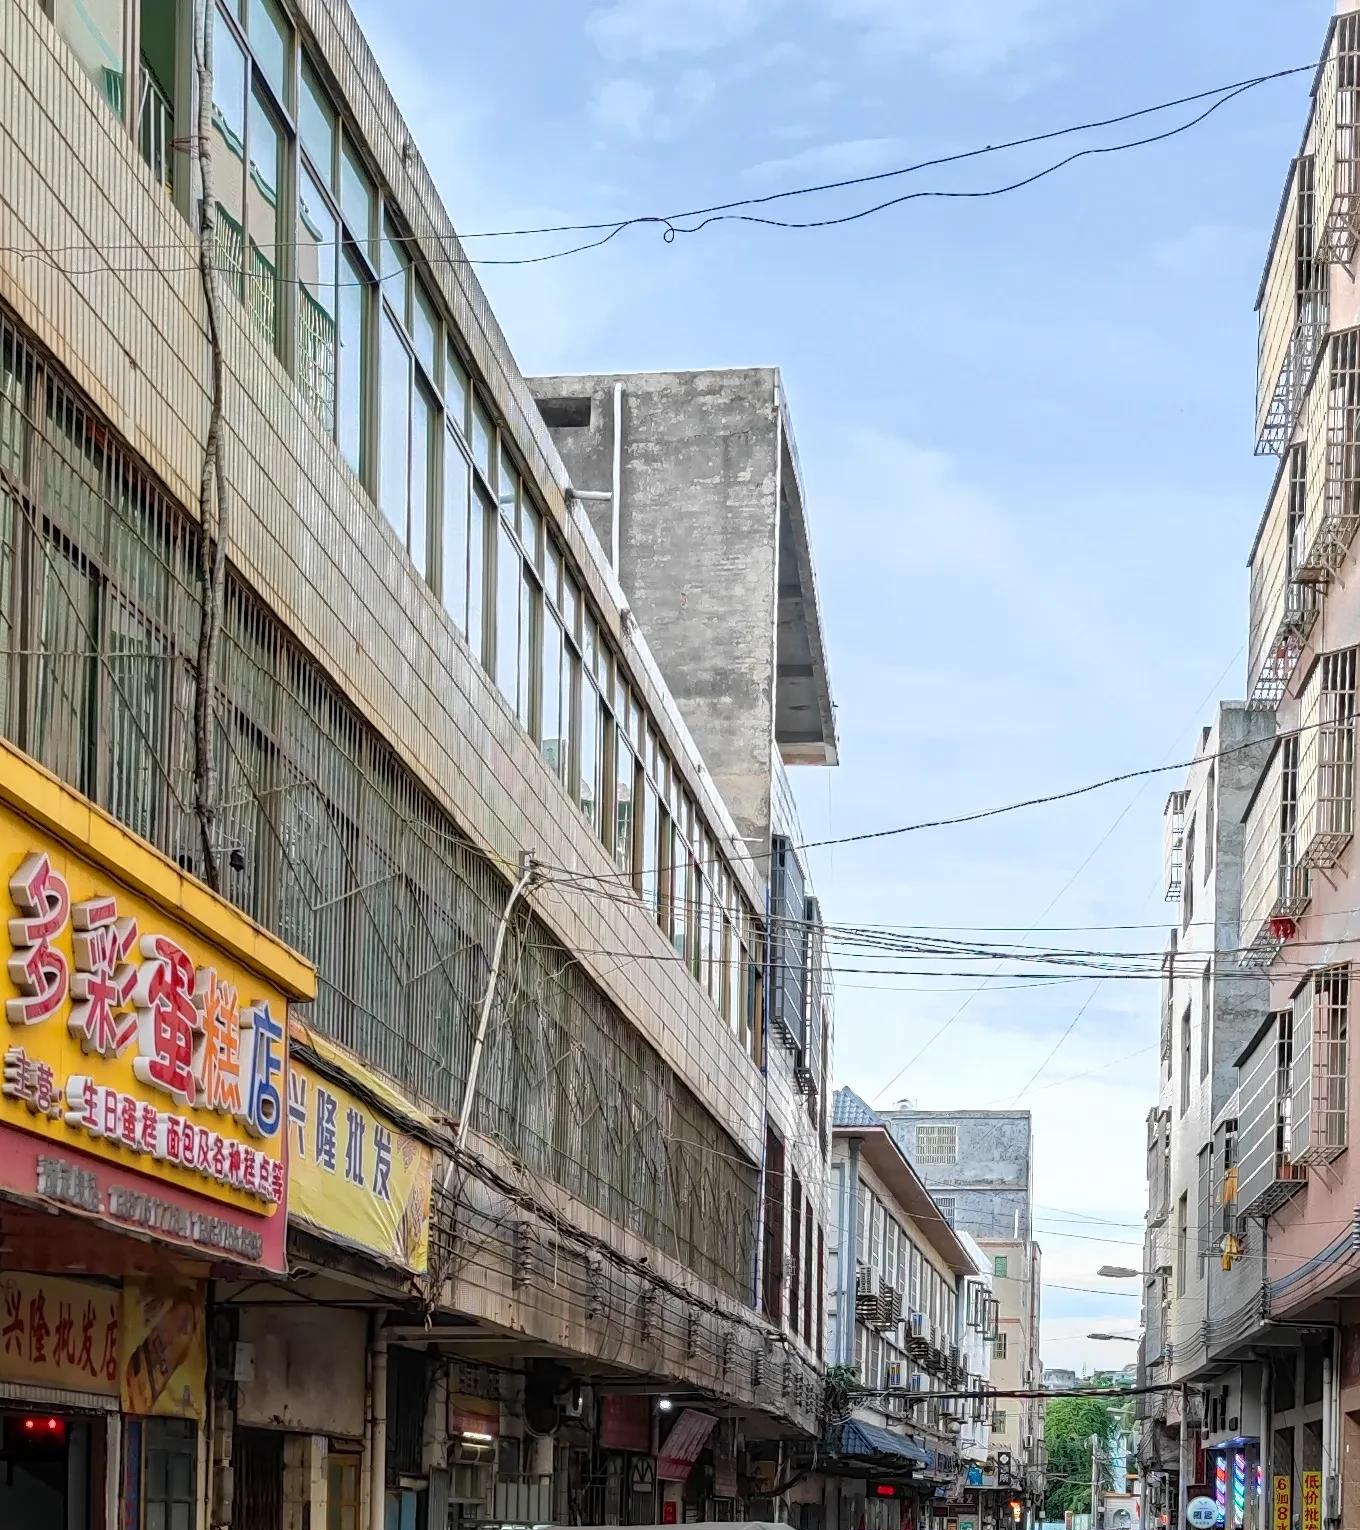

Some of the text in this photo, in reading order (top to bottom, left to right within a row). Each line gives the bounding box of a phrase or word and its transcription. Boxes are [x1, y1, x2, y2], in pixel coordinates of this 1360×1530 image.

[10, 850, 283, 1140] 多彩蛋糕店
[1, 1287, 120, 1382] 兴隆批发店
